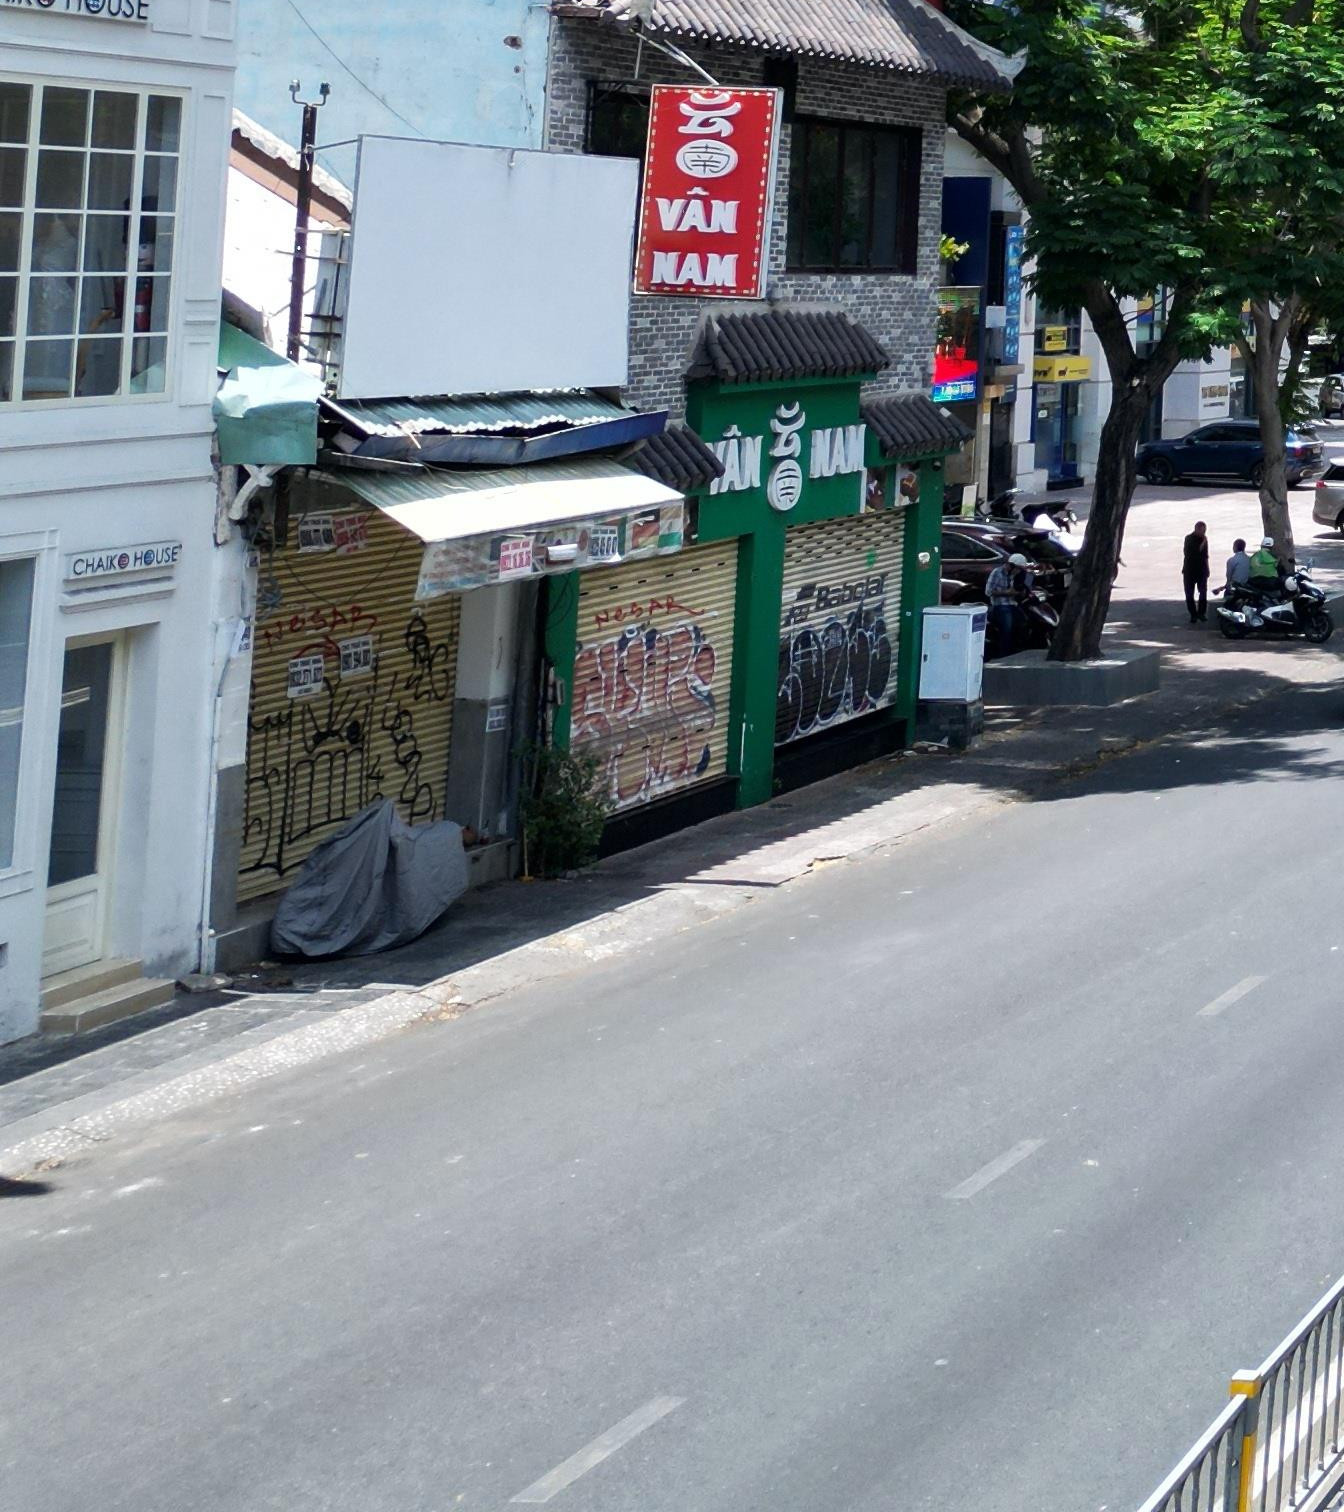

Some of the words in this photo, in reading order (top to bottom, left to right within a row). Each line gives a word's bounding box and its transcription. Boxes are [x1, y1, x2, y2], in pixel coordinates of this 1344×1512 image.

[655, 187, 740, 233] VÂN
[652, 252, 739, 287] NAM
[809, 424, 867, 478] NAM
[73, 553, 129, 575] CHAIKO
